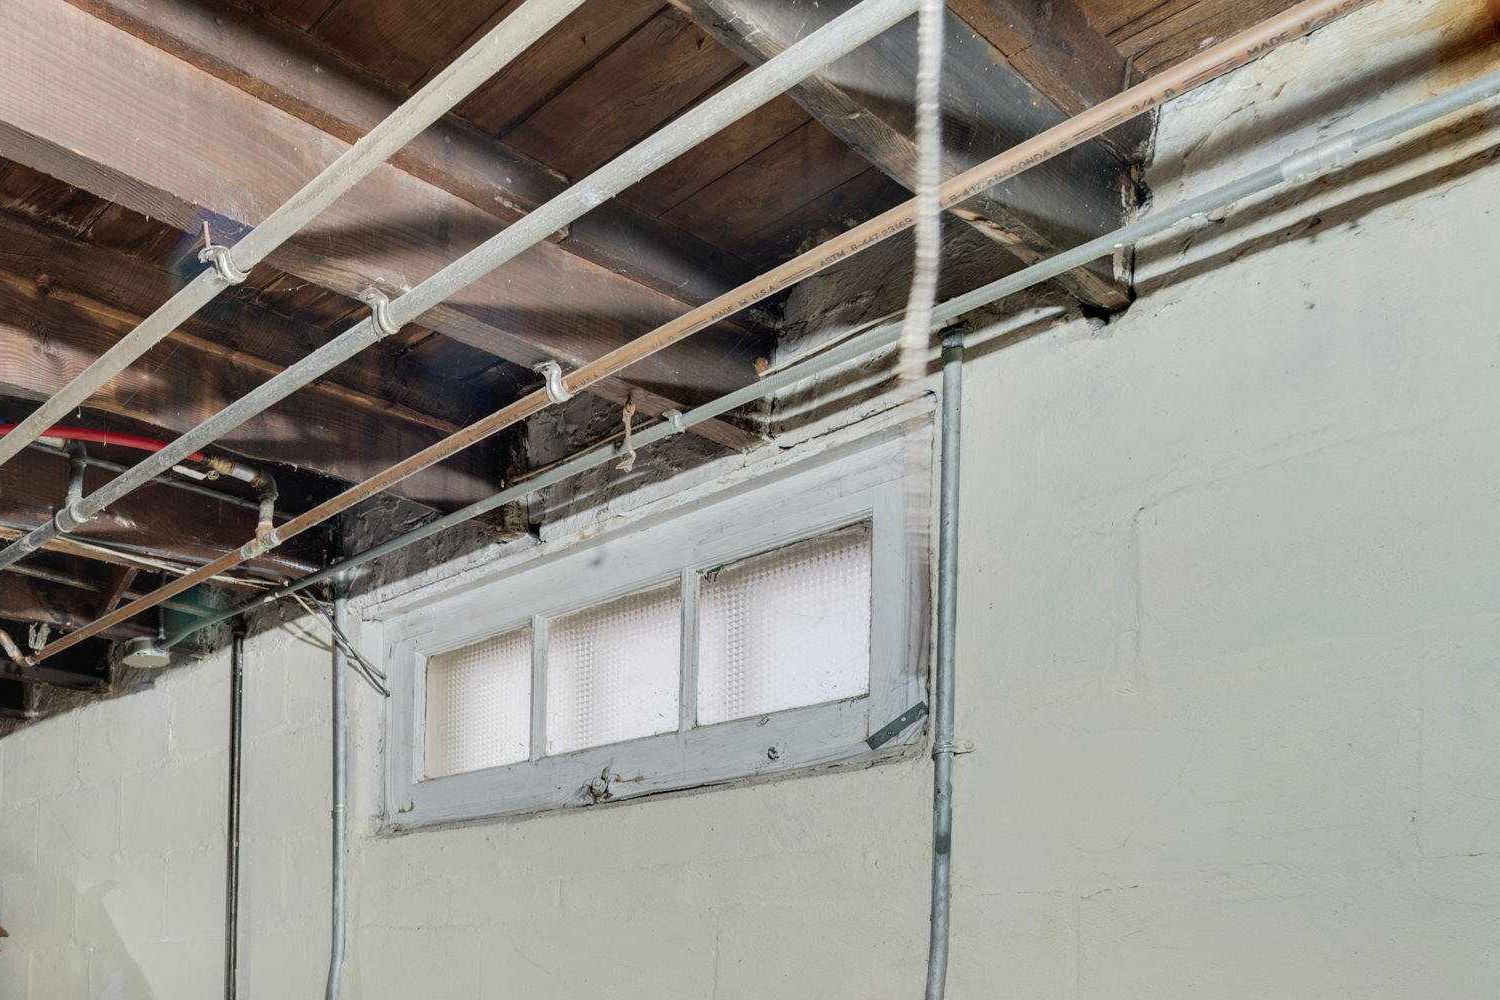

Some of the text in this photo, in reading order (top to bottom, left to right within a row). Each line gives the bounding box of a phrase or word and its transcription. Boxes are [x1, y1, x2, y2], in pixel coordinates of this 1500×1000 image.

[1246, 30, 1290, 57] MADE
[987, 149, 1052, 184] ANACONDA
[820, 249, 845, 268] ASTM
[850, 232, 879, 251] B-447
[710, 305, 733, 321] MADE
